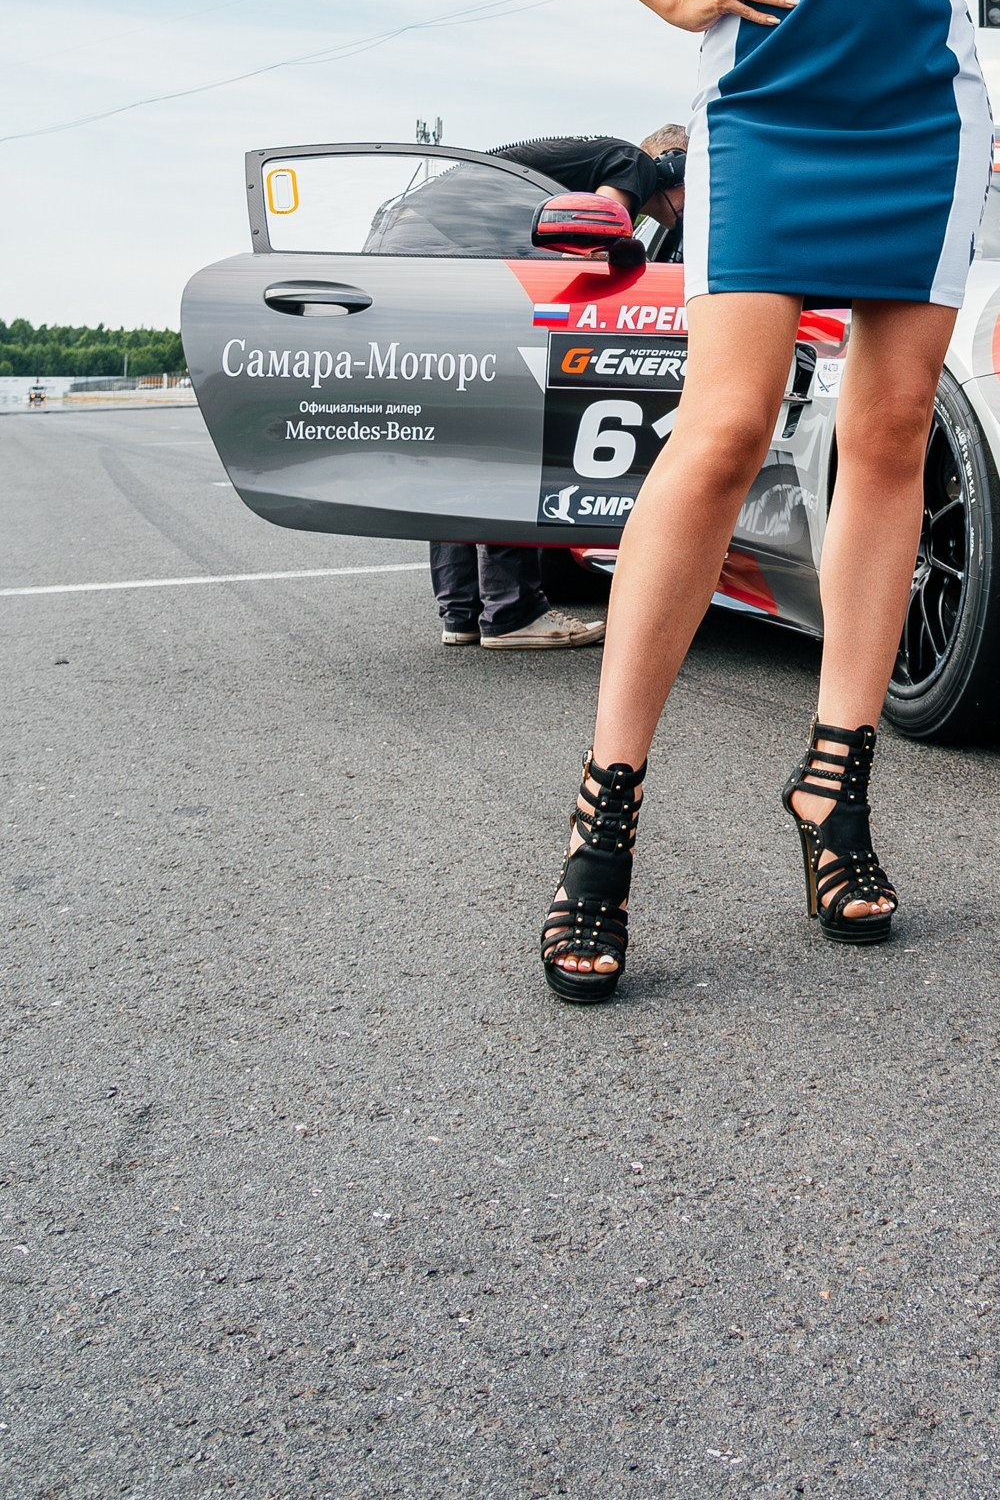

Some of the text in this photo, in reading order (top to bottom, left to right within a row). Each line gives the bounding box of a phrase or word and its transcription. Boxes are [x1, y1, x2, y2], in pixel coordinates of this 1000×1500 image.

[576, 304, 607, 328] А.
[221, 338, 498, 391] Самара-Моторс
[385, 402, 421, 416] дилер
[285, 421, 435, 442] Mercedes-Benz
[573, 399, 680, 479] 6
[578, 496, 634, 517] SMP
